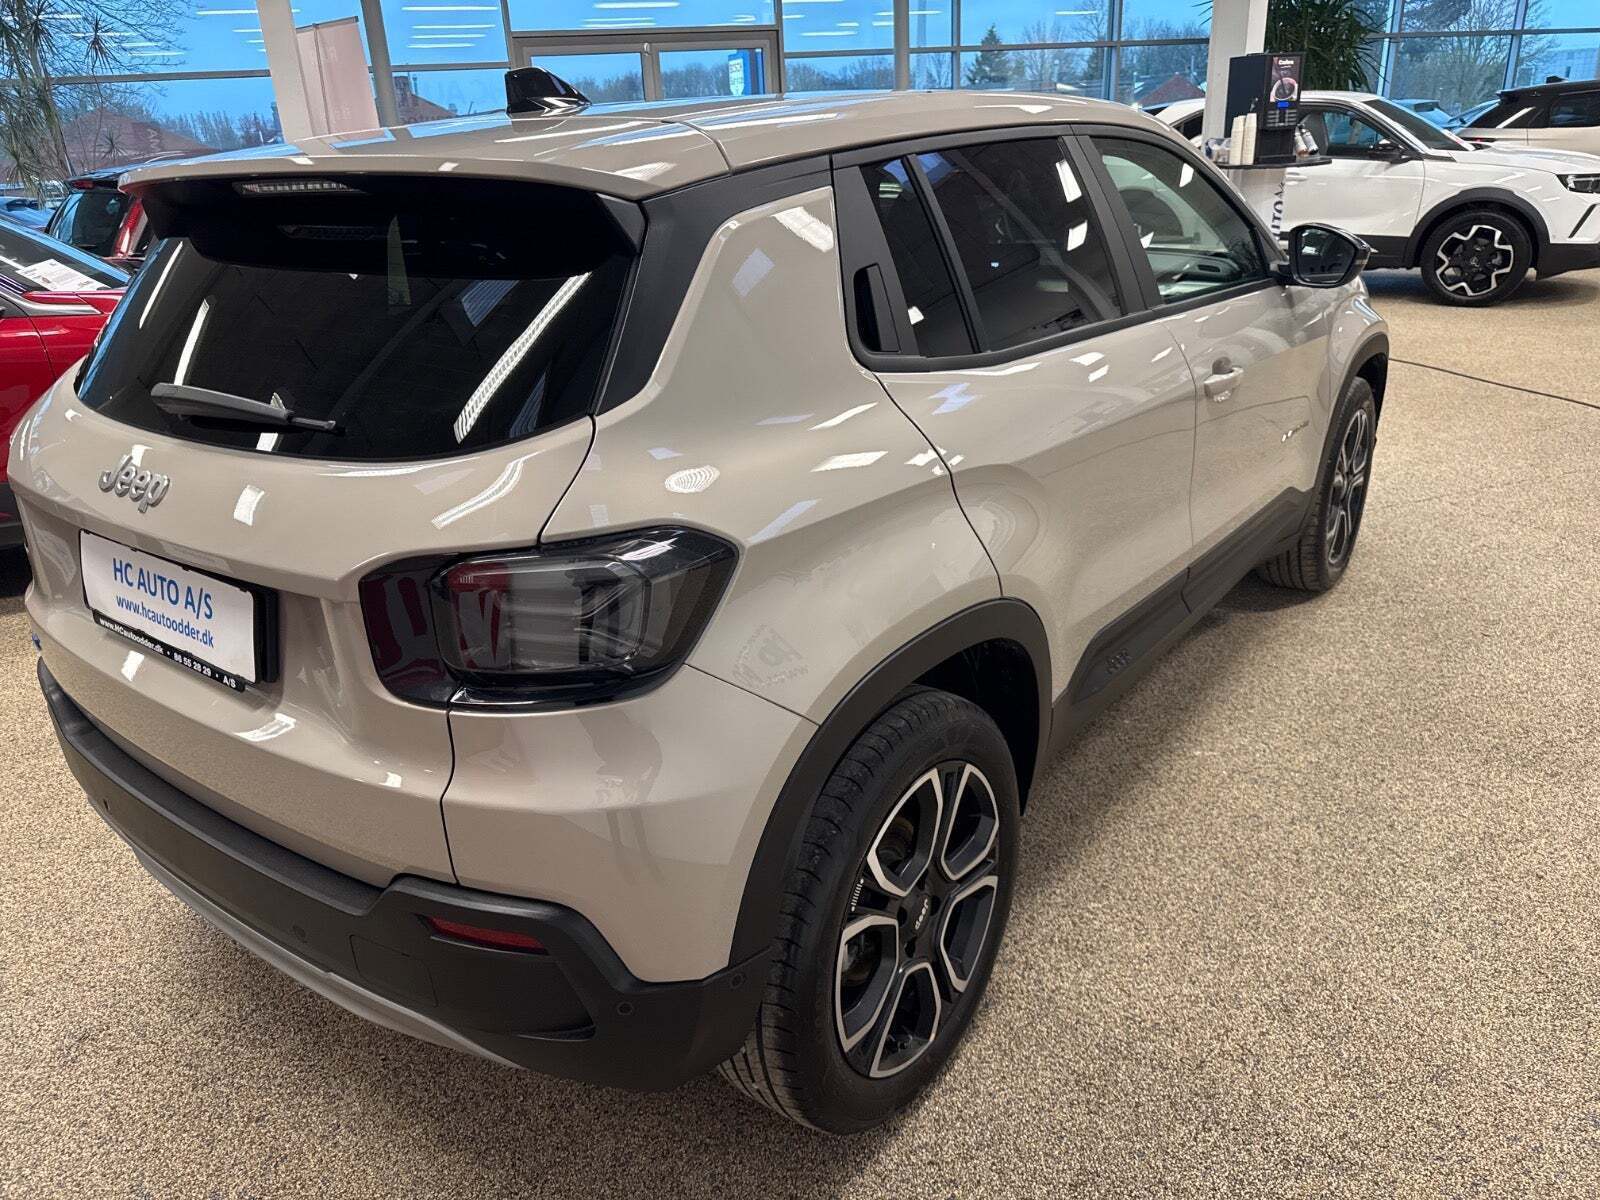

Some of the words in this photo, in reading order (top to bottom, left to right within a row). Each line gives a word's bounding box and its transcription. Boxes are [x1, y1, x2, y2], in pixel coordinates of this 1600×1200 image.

[98, 454, 170, 514] Jeep
[113, 557, 134, 587] HC
[137, 567, 179, 606] AUTO
[184, 586, 213, 620] A/S
[116, 595, 214, 648] www.hcautoodder.dk
[222, 675, 237, 688] A/S
